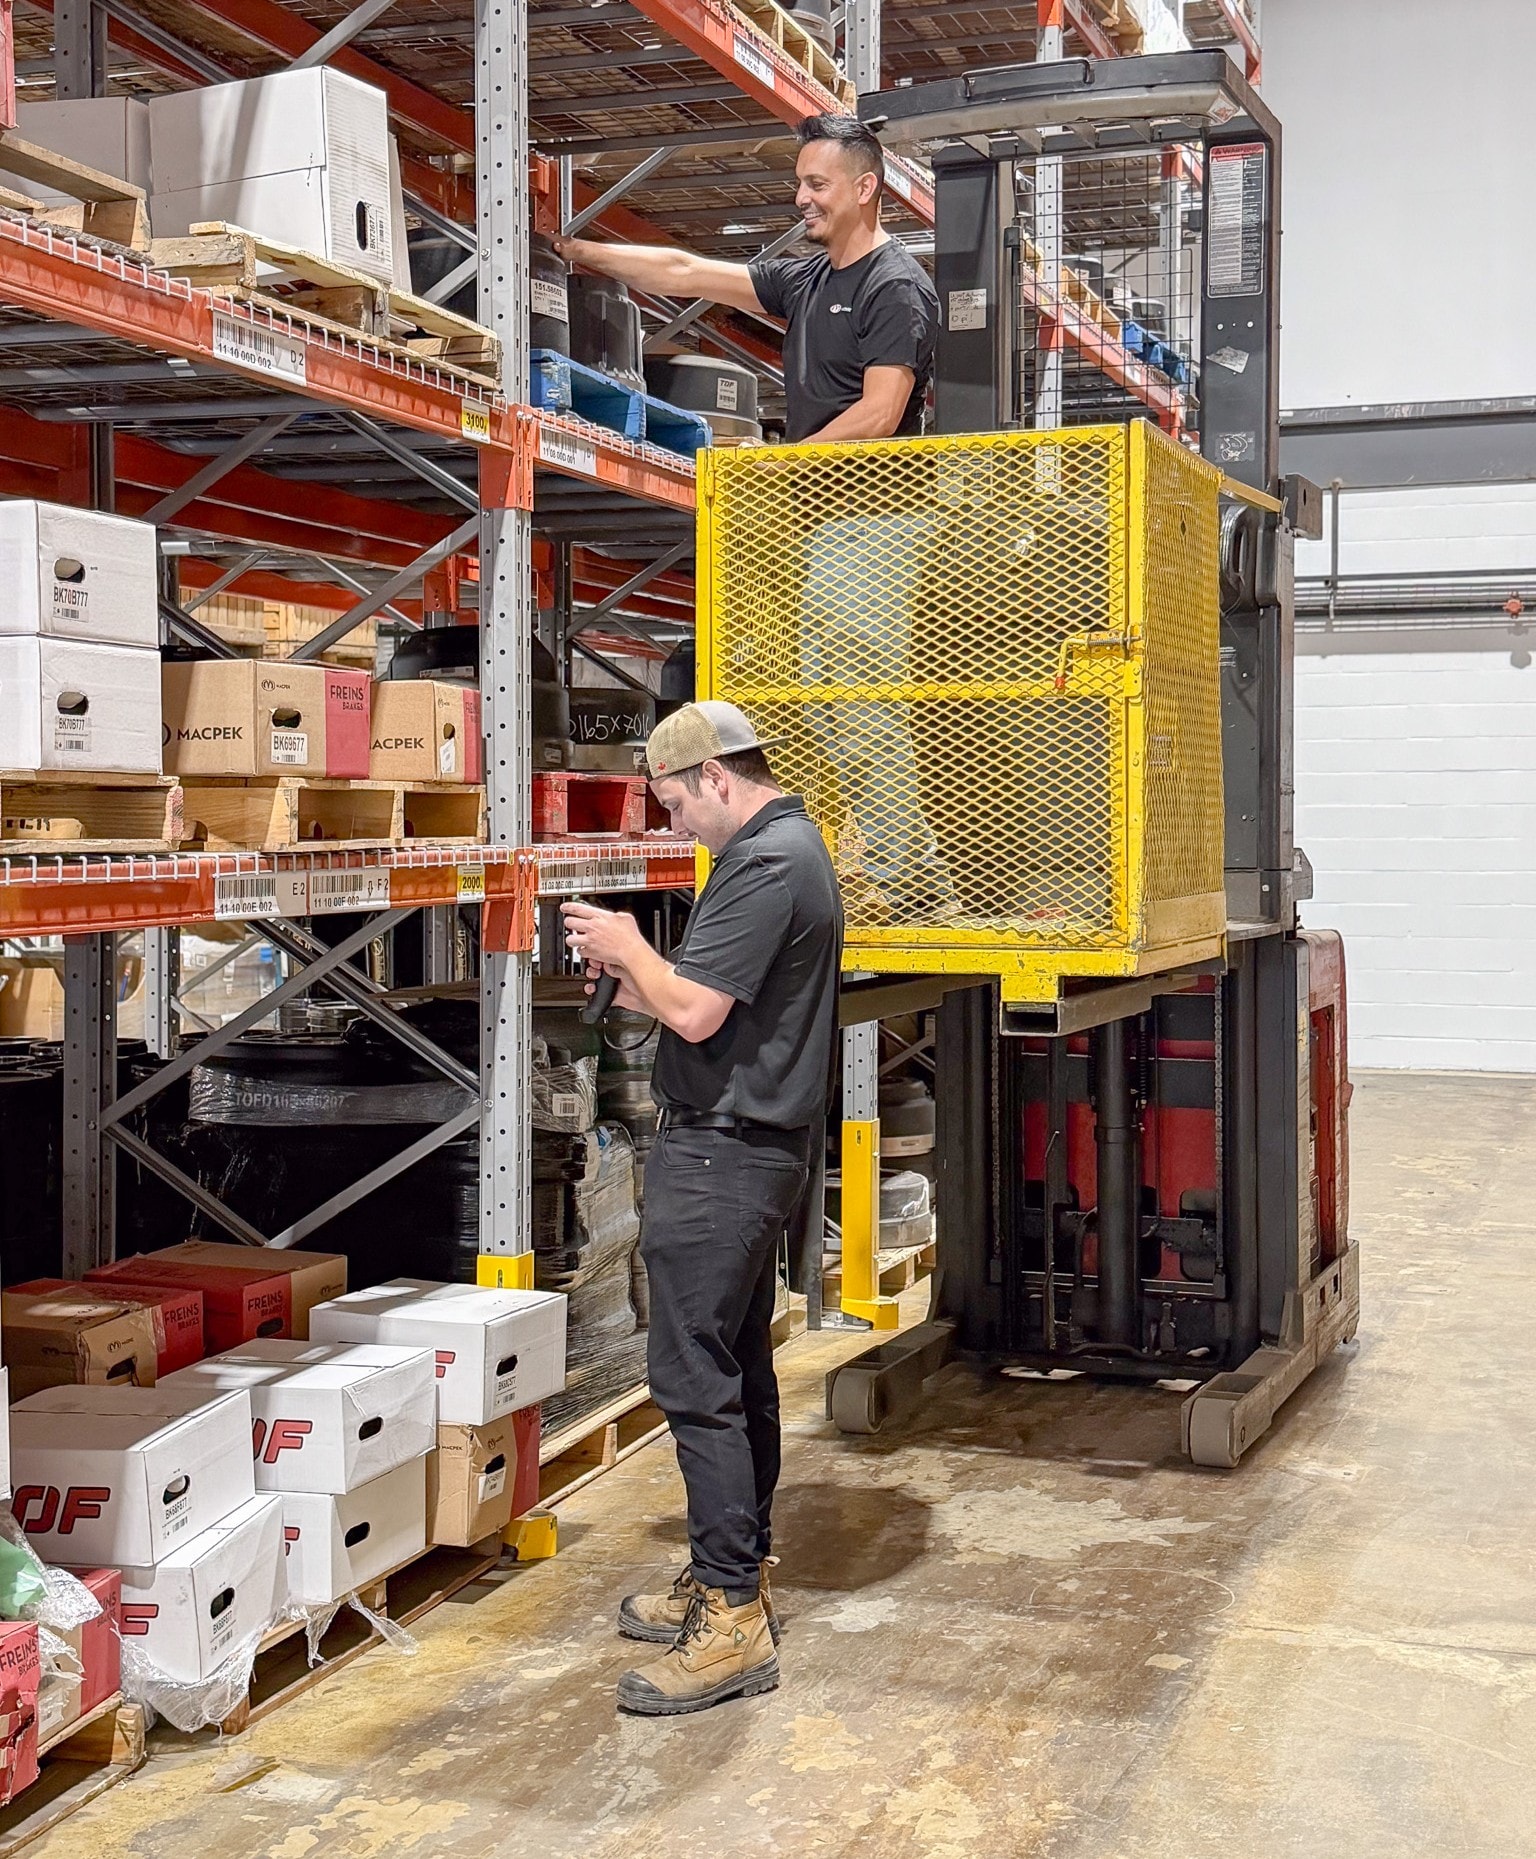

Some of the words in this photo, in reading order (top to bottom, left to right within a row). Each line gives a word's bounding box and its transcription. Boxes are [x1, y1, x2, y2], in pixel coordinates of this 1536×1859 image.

[218, 342, 227, 354] 11
[230, 346, 239, 359] 10
[240, 350, 256, 364] 00D
[257, 356, 272, 370] 002
[53, 586, 89, 607] BK70B777
[330, 685, 364, 701] FREINS
[342, 702, 364, 711] BRAKES
[176, 726, 243, 741] MACPEK
[273, 735, 305, 752] BK69677
[370, 737, 425, 750] ACPEK
[292, 882, 298, 895] E
[299, 882, 305, 895] 2
[220, 904, 228, 914] 11
[231, 903, 240, 914] 10
[242, 902, 257, 913] 00E
[258, 901, 273, 912] 002
[314, 898, 322, 908] 11
[324, 897, 332, 908] 10
[333, 896, 346, 907] 00F
[347, 895, 360, 906] 002
[247, 1290, 283, 1312] FREINS
[164, 1303, 200, 1326] FREINS
[11, 1485, 111, 1535] OF
[0, 1637, 38, 1672] FREINS
